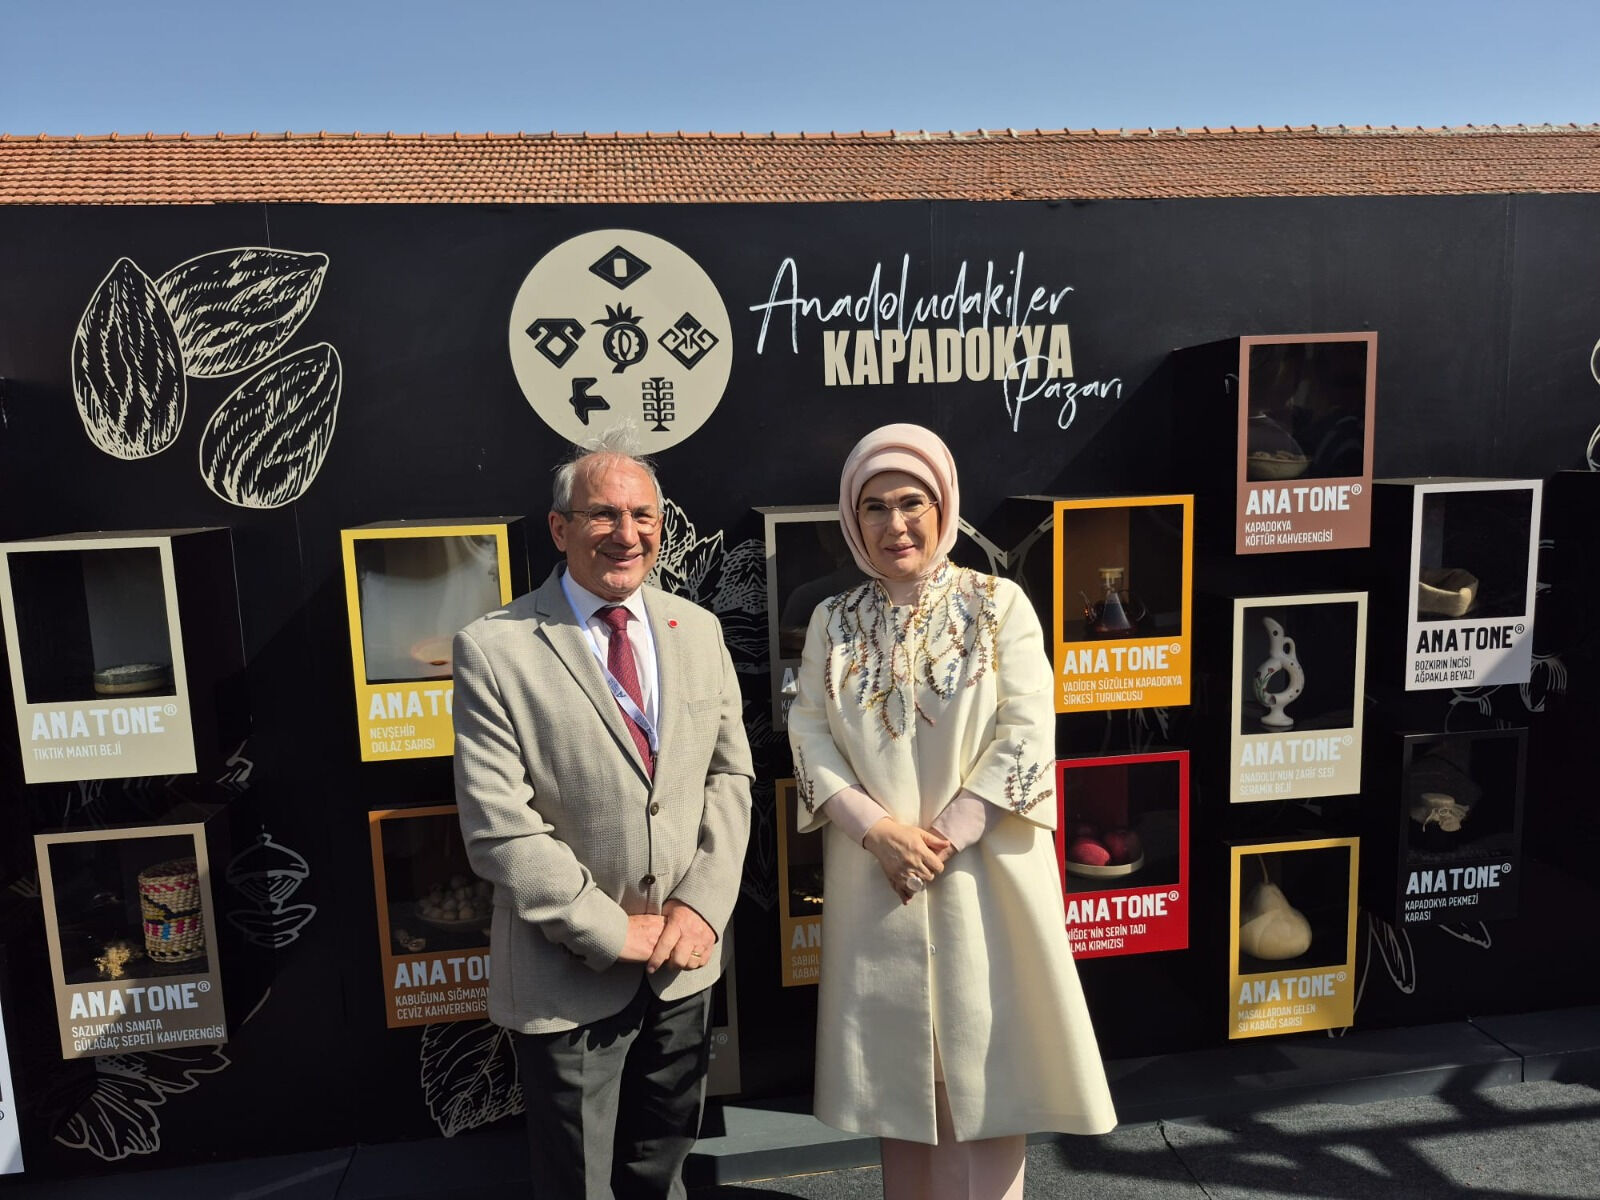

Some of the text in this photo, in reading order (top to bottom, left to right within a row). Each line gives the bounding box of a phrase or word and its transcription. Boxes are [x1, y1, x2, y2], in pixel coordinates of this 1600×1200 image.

[749, 251, 1075, 354] Anadoludakiler
[823, 324, 1074, 386] KAPADOKYA
[1245, 520, 1292, 533] KAPADOKYA
[1245, 529, 1333, 547] KÖFTÜR KAHVERENGİSİ
[1415, 659, 1448, 671] BOZKIRIN
[1063, 675, 1183, 692] VADİDEN SÜZÜLEN KAPADOKYA
[1414, 670, 1475, 684] AĞPAKLA BEYAZI
[1096, 690, 1143, 703] TURUNCUSU
[66, 744, 97, 759] MANTI
[1405, 893, 1479, 911] KAPADOKYA PEKMEZİ
[1405, 910, 1431, 923] KARASI
[1105, 924, 1128, 937] SERİN
[1129, 923, 1146, 935] TADI
[1070, 938, 1124, 953] LMA KIRMIZISI
[395, 991, 446, 1006] KABUĞUNA
[425, 999, 487, 1017] KAHVERENGİS
[71, 1018, 163, 1038] SAZLIKTAN SANATA
[74, 1024, 225, 1052] GÜLAĞAÇ SEPETİ KAHVERENGİSİ
